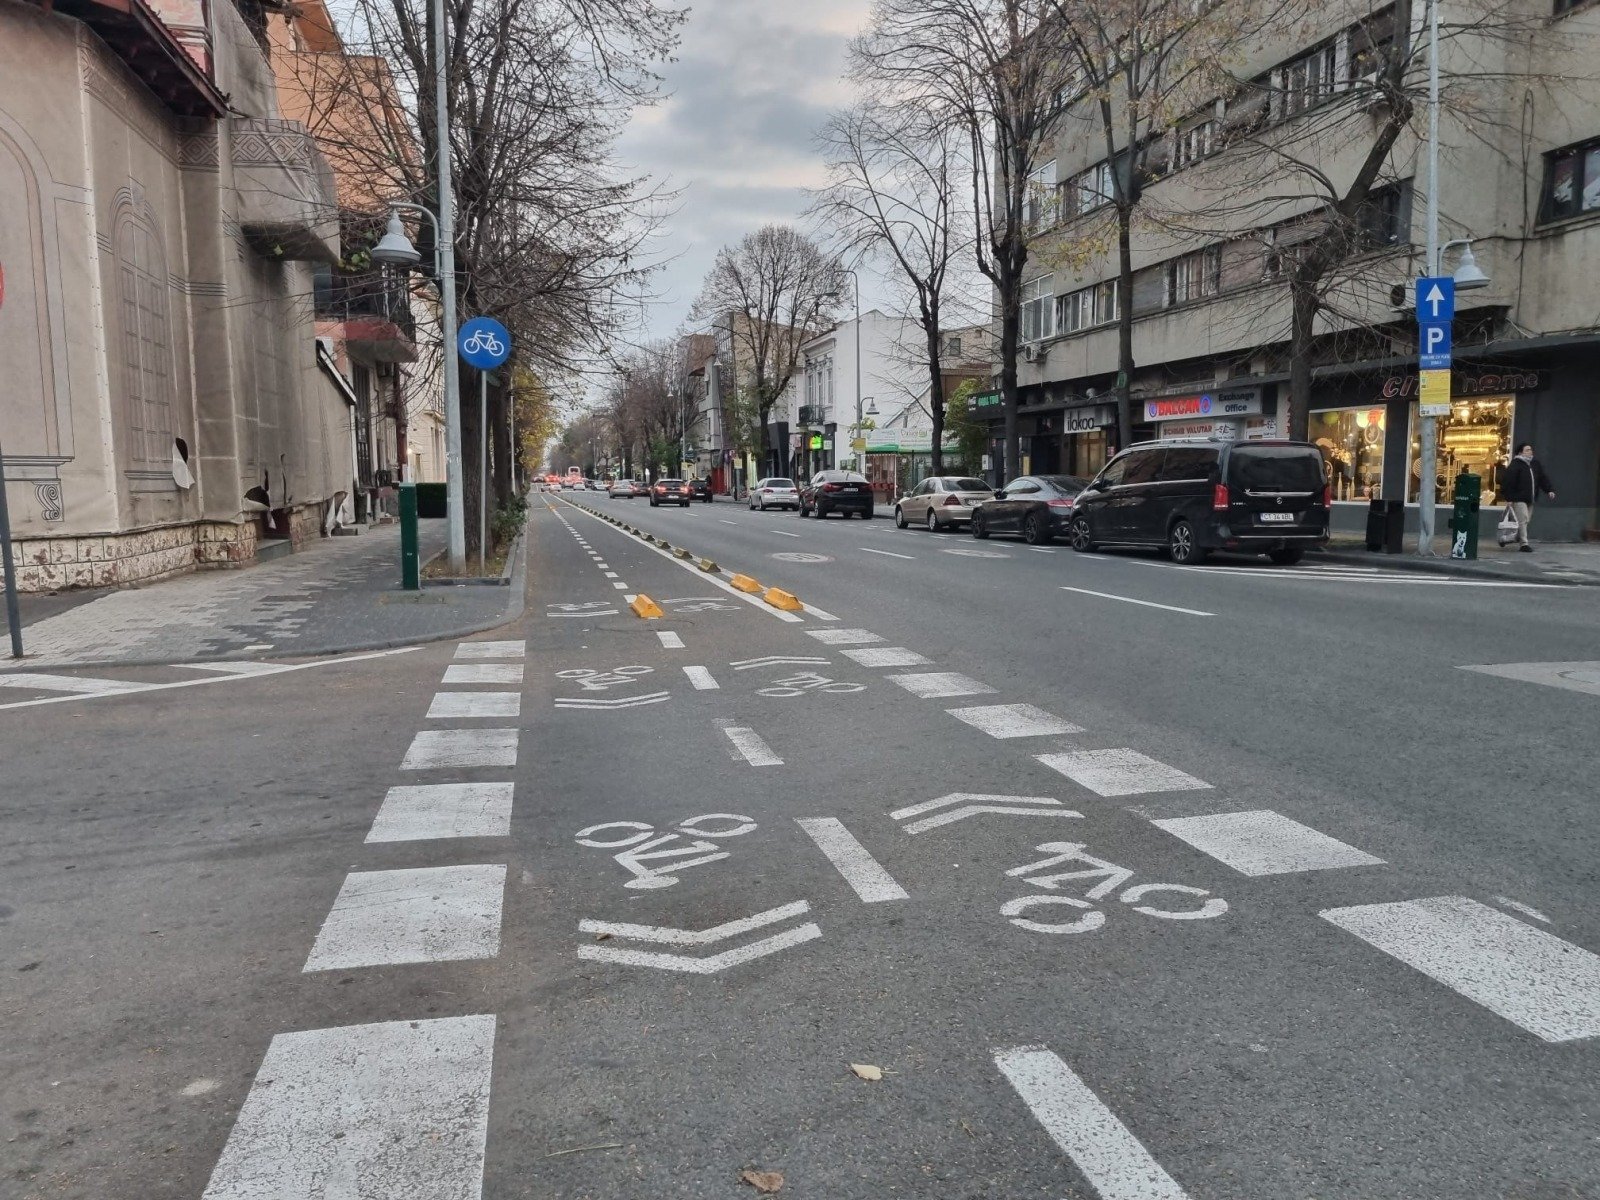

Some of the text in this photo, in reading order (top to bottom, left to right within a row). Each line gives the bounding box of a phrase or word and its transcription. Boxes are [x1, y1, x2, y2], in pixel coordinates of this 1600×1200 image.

[1428, 328, 1444, 354] P
[1218, 391, 1255, 402] Exchange
[1157, 396, 1200, 416] BALCAN
[1225, 404, 1247, 413] Office
[1186, 425, 1212, 434] VALUTAR
